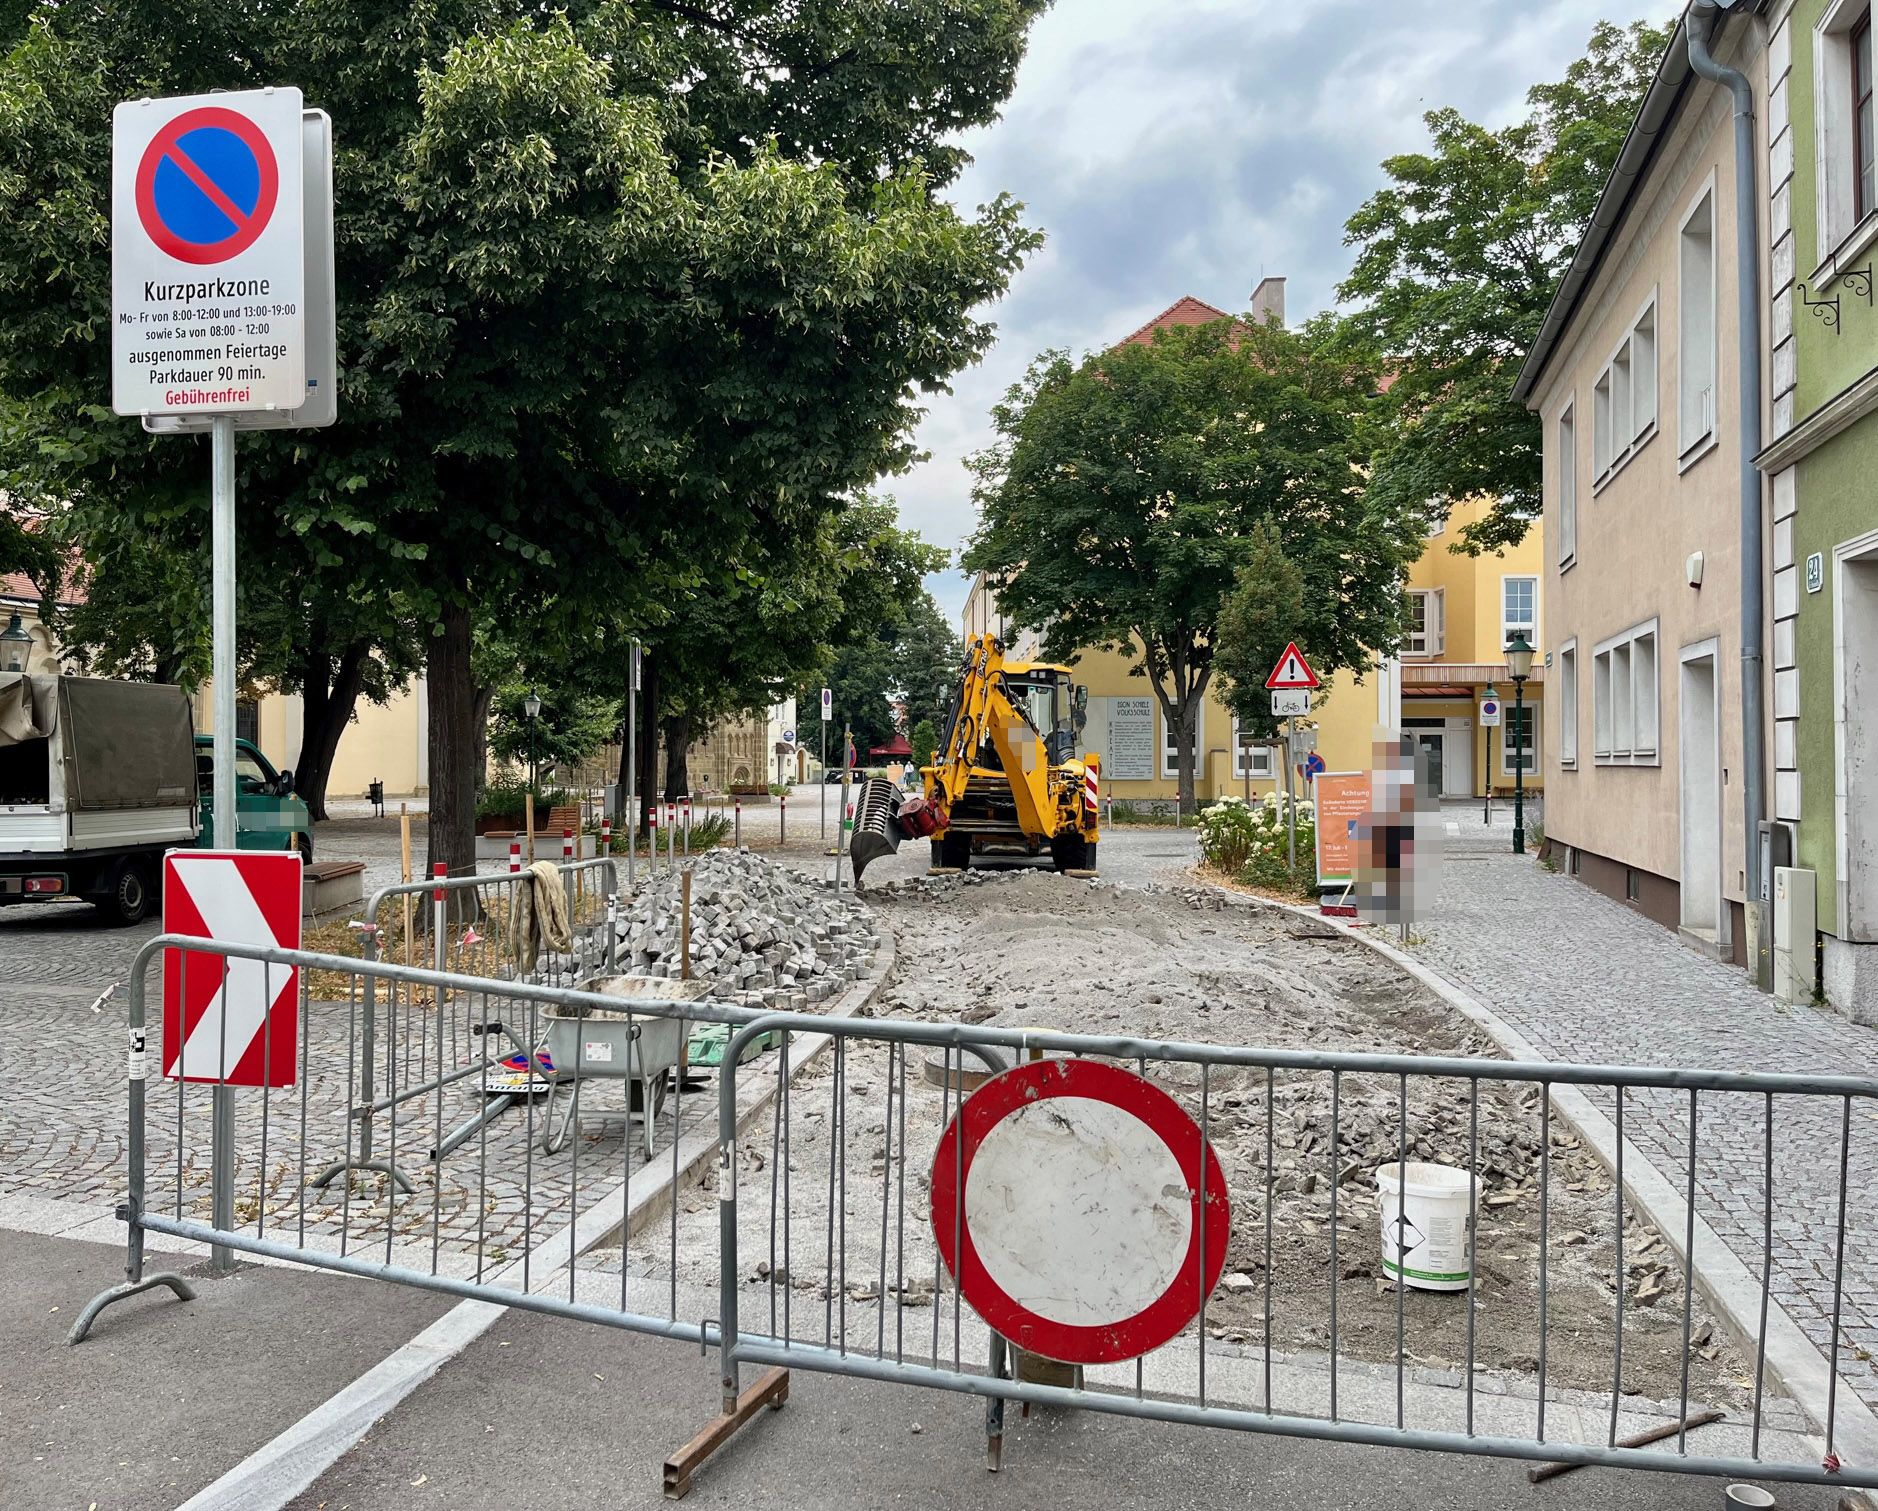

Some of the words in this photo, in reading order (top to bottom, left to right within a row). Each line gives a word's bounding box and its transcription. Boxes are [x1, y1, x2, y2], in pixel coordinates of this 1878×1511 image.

[144, 277, 270, 304] Kurzparkzone
[119, 312, 137, 324] Mo-
[140, 312, 149, 323] Fr
[151, 313, 169, 322] von
[172, 308, 220, 321] 8:00-12:00
[223, 306, 241, 319] und
[244, 303, 296, 317] 13:00-19:00
[145, 327, 173, 340] sowie
[175, 327, 187, 339] Sa
[189, 329, 206, 338] von
[210, 325, 235, 337] 08:00
[245, 323, 270, 335] 12:00
[129, 348, 221, 365] ausgenommen
[226, 343, 287, 360] Feiertage
[149, 368, 214, 384] Parkdauer
[218, 366, 233, 380] 90
[237, 364, 266, 380] min.
[165, 386, 250, 405] Gebührenfrei
[1808, 557, 1818, 580] 24
